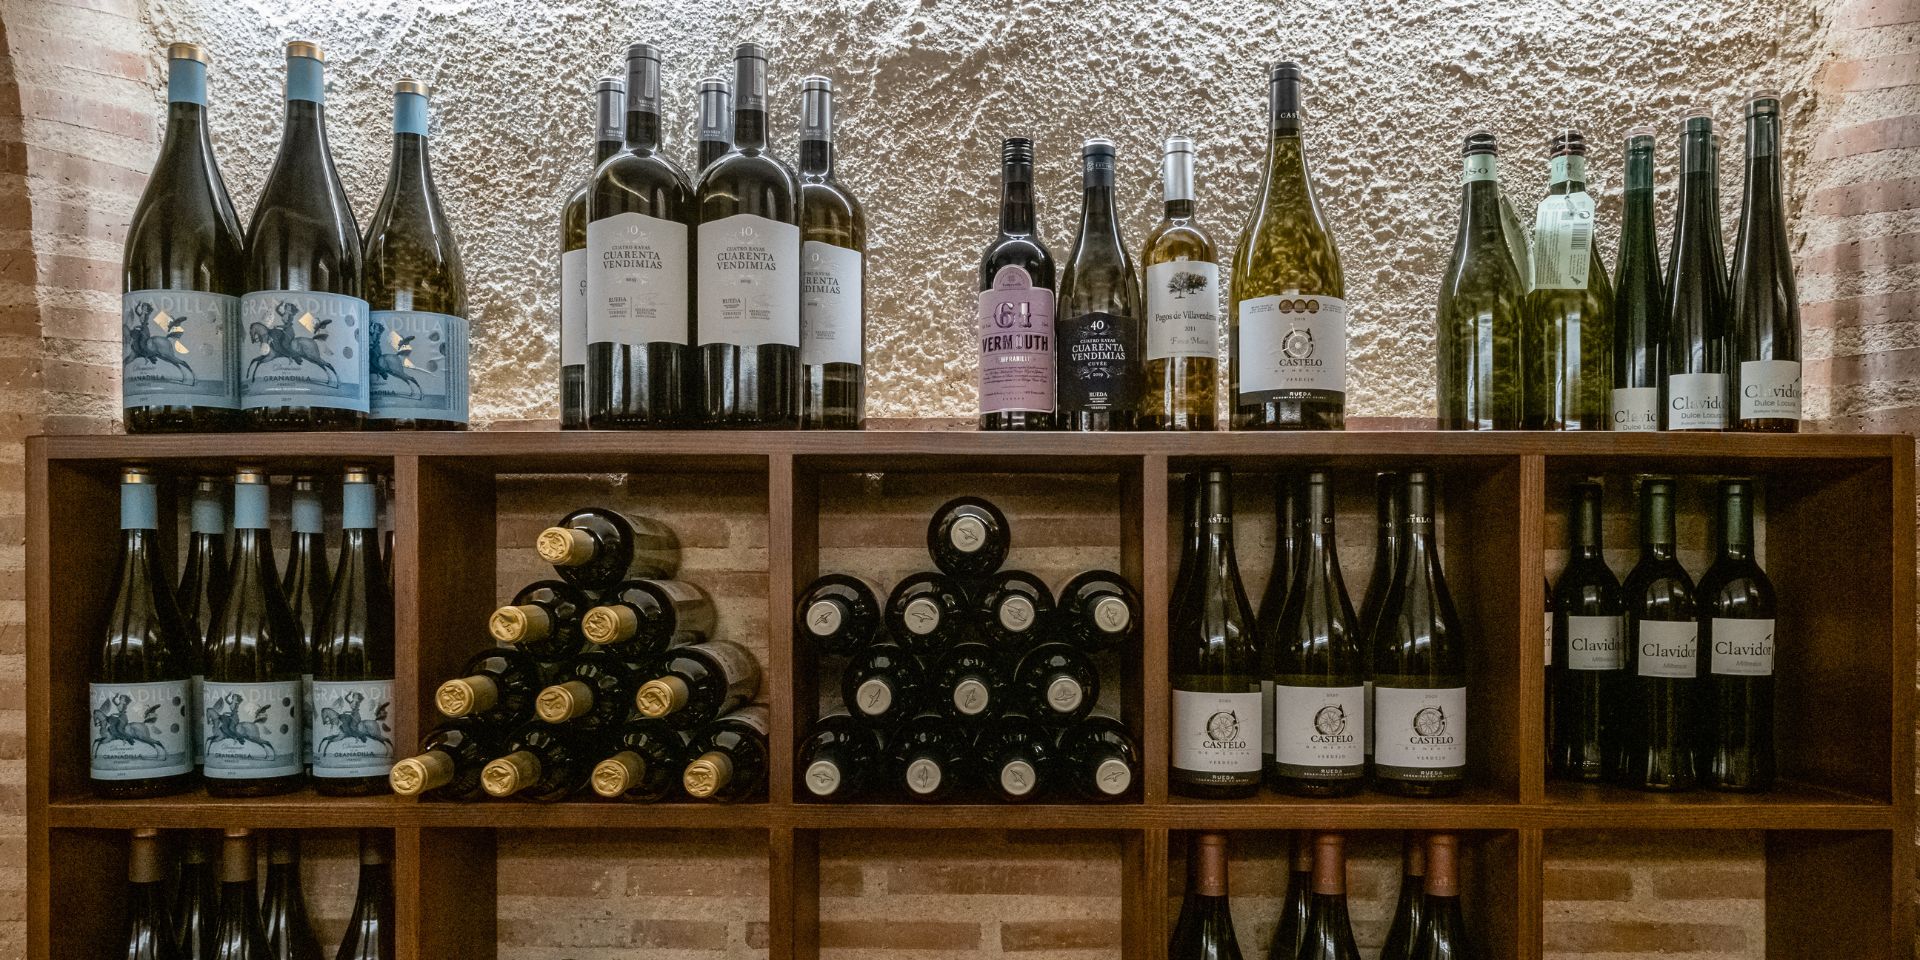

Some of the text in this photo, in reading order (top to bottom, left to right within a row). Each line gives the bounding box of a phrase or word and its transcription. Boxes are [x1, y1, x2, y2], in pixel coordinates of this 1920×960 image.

[603, 251, 660, 260] CUARENTA
[717, 252, 774, 261] CUARENTA
[603, 260, 663, 269] VENDIMIAS
[716, 262, 776, 270] VENDIMIAS
[993, 302, 1032, 328] 61
[1155, 313, 1173, 323] Pagos
[1173, 312, 1181, 320] de
[1090, 320, 1104, 330] 40
[982, 334, 1049, 352] VERMOUTH
[1072, 343, 1124, 353] CUARENTA
[1071, 352, 1126, 361] VENDIMIAS
[1279, 359, 1323, 367] CASTELO
[1311, 735, 1354, 743] CASTELO
[1410, 736, 1454, 744] CASTELO
[1203, 740, 1247, 749] CASTELO
